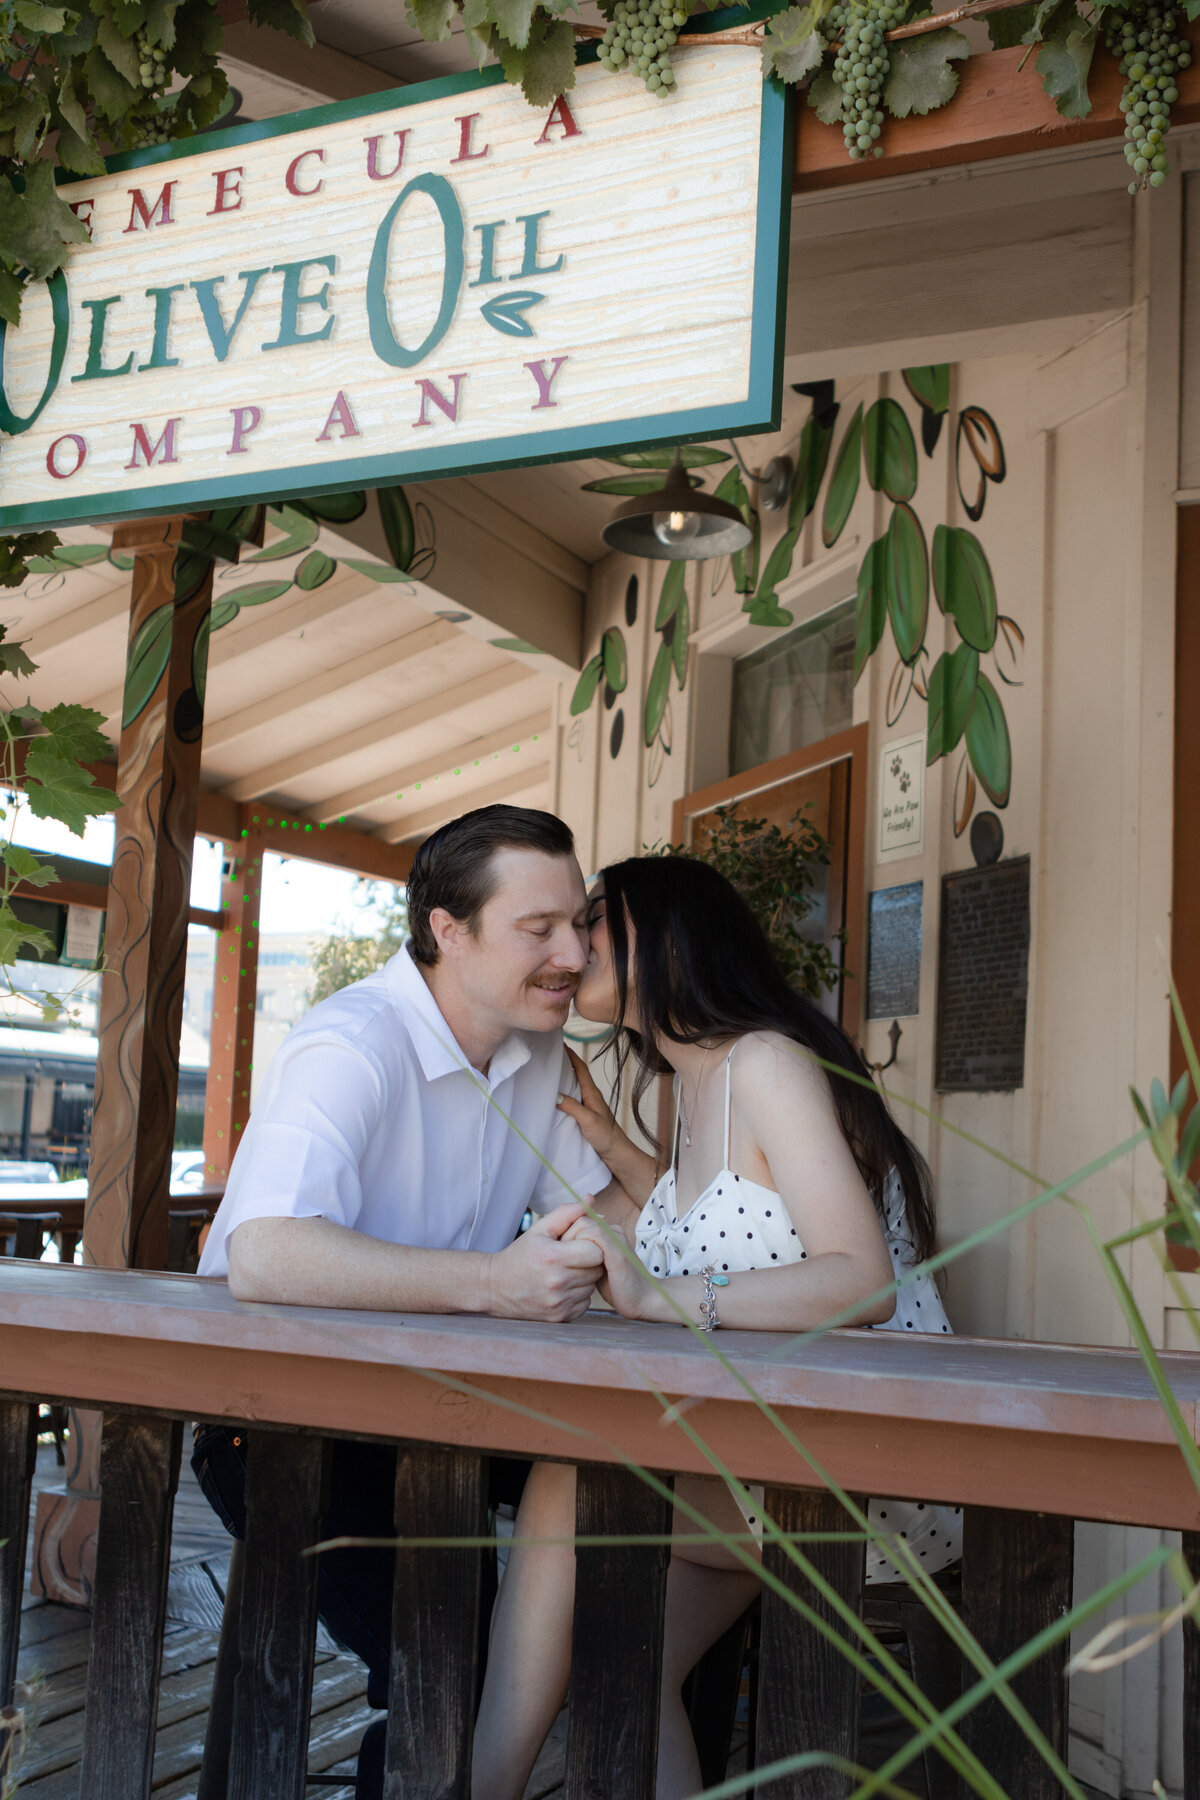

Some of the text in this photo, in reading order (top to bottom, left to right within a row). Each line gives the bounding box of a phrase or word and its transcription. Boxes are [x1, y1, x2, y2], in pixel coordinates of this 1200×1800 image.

[62, 93, 583, 246] EMECULA
[0, 171, 566, 436] OLIVE OIL
[46, 356, 569, 480] OMPANY
[894, 805, 905, 815] Are
